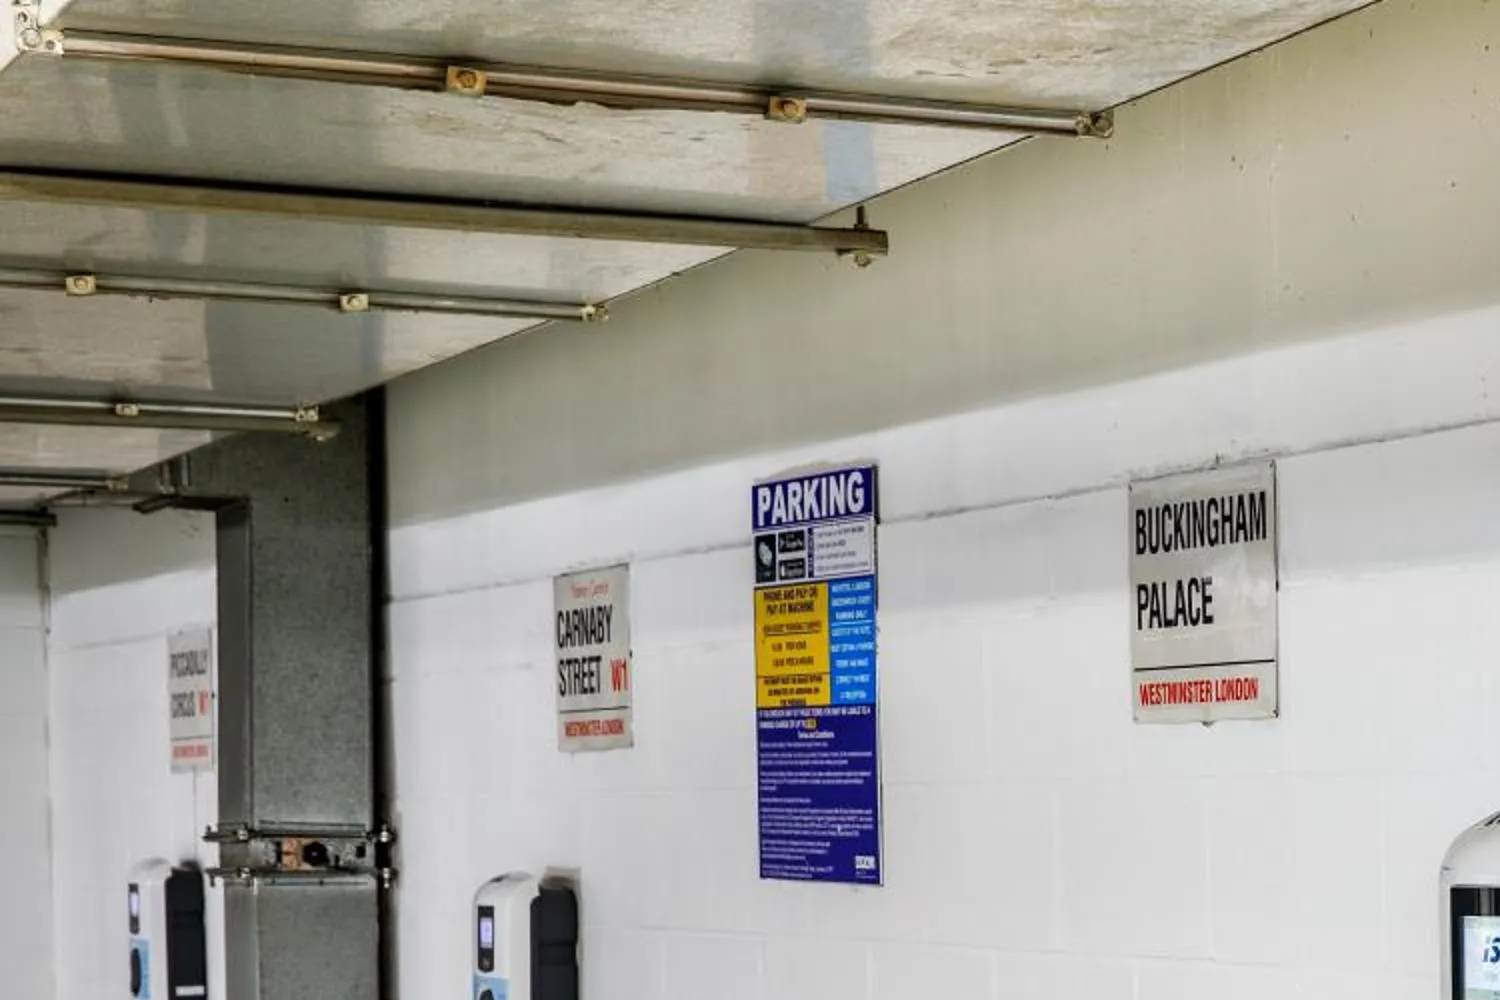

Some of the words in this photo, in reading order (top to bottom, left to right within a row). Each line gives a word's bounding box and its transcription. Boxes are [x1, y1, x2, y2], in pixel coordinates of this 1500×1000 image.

[757, 470, 865, 527] PARKING
[1135, 490, 1268, 556] BUCKINGHAM
[557, 604, 613, 648] CARNABY
[1136, 576, 1215, 631] PALACE
[559, 655, 603, 697] STREET
[609, 657, 628, 692] W1
[1139, 680, 1213, 708] WESTMINSTER
[1215, 677, 1259, 702] LONDON
